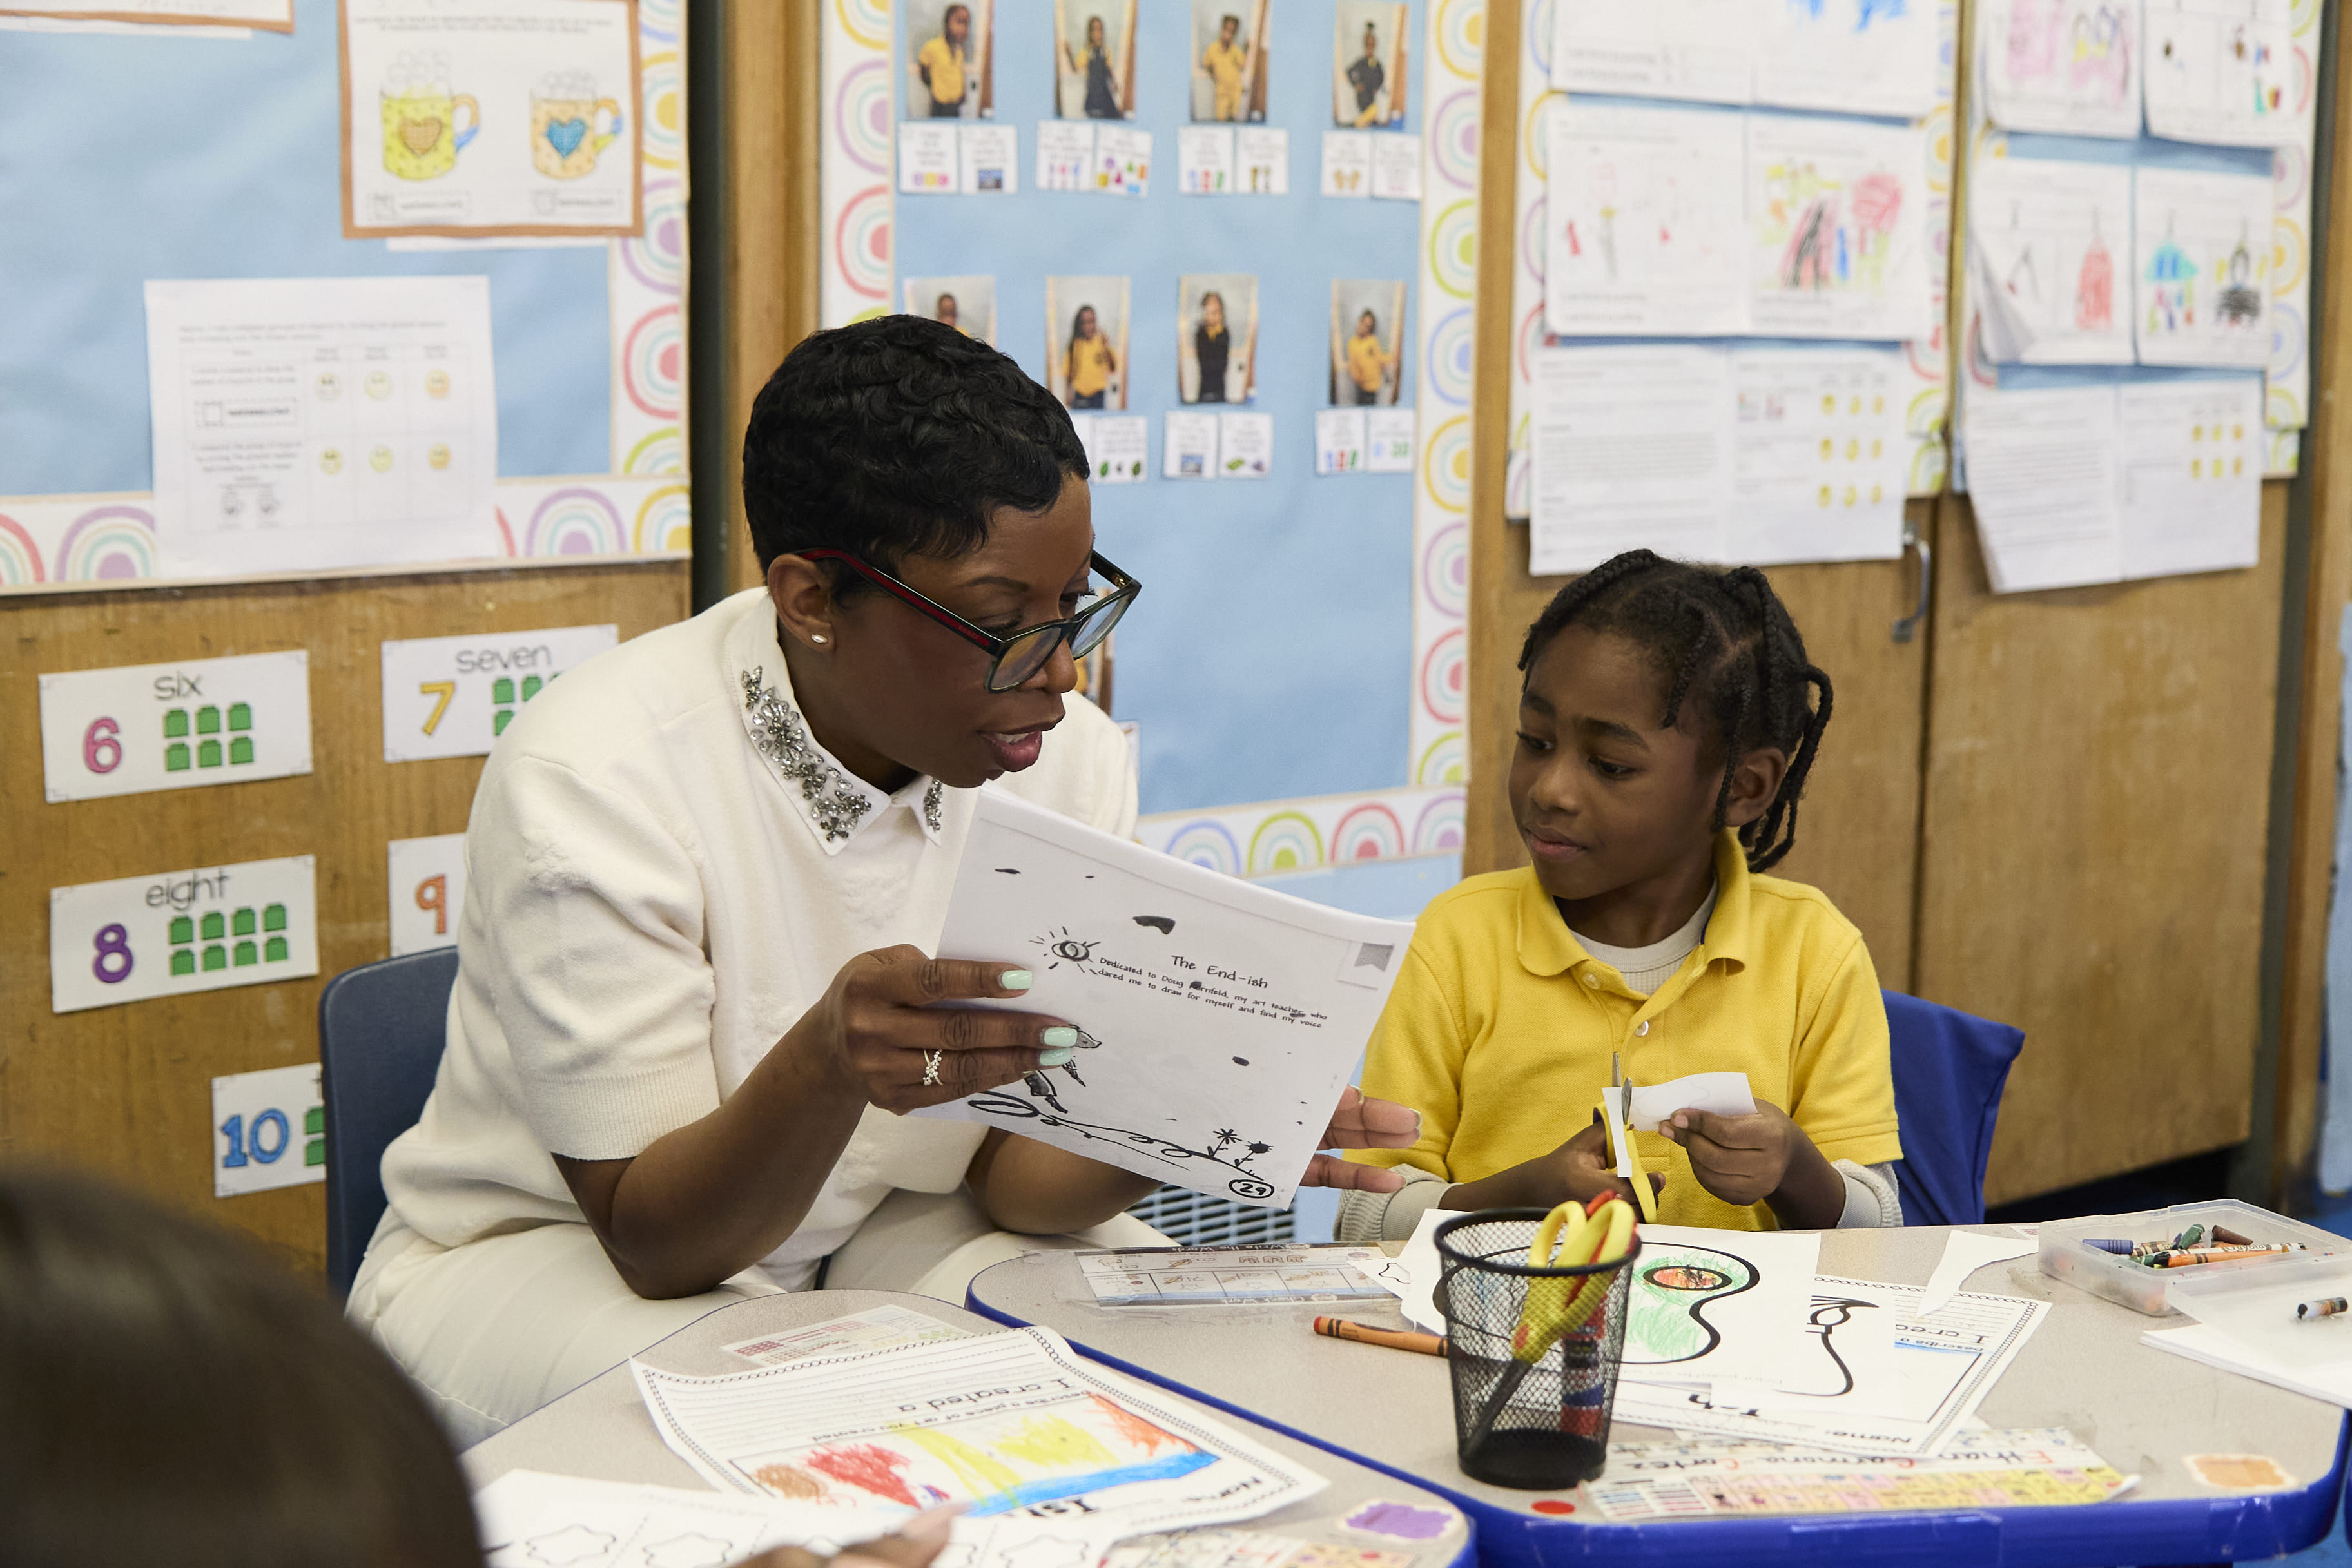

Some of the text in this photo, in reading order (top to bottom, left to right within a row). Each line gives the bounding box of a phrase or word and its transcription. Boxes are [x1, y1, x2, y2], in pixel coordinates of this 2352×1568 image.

[456, 644, 552, 674] seven
[153, 670, 204, 701] six
[420, 680, 456, 737] 7
[83, 717, 122, 774] 6
[146, 866, 231, 913] eight
[415, 873, 448, 934] 9
[92, 923, 135, 983] 8
[1100, 957, 1143, 975] Dedicated
[1161, 975, 1184, 989] Doug
[1234, 995, 1248, 1004] my
[1171, 954, 1268, 989] The End-ish
[1098, 968, 1123, 981] dared
[1161, 985, 1182, 996] draw
[1187, 992, 1201, 1000] for
[1205, 998, 1235, 1010] myself
[1238, 1005, 1255, 1014] and
[1259, 1009, 1277, 1019] find
[1281, 1015, 1296, 1025] my
[1299, 1019, 1323, 1028] voice
[220, 1107, 291, 1168] 10
[1239, 1183, 1267, 1196] 29
[1916, 1339, 1984, 1351] Describe
[898, 1404, 917, 1412] a
[927, 1383, 1042, 1411] created
[1825, 1429, 1912, 1444] Name:
[1938, 1449, 2055, 1465] Ethan
